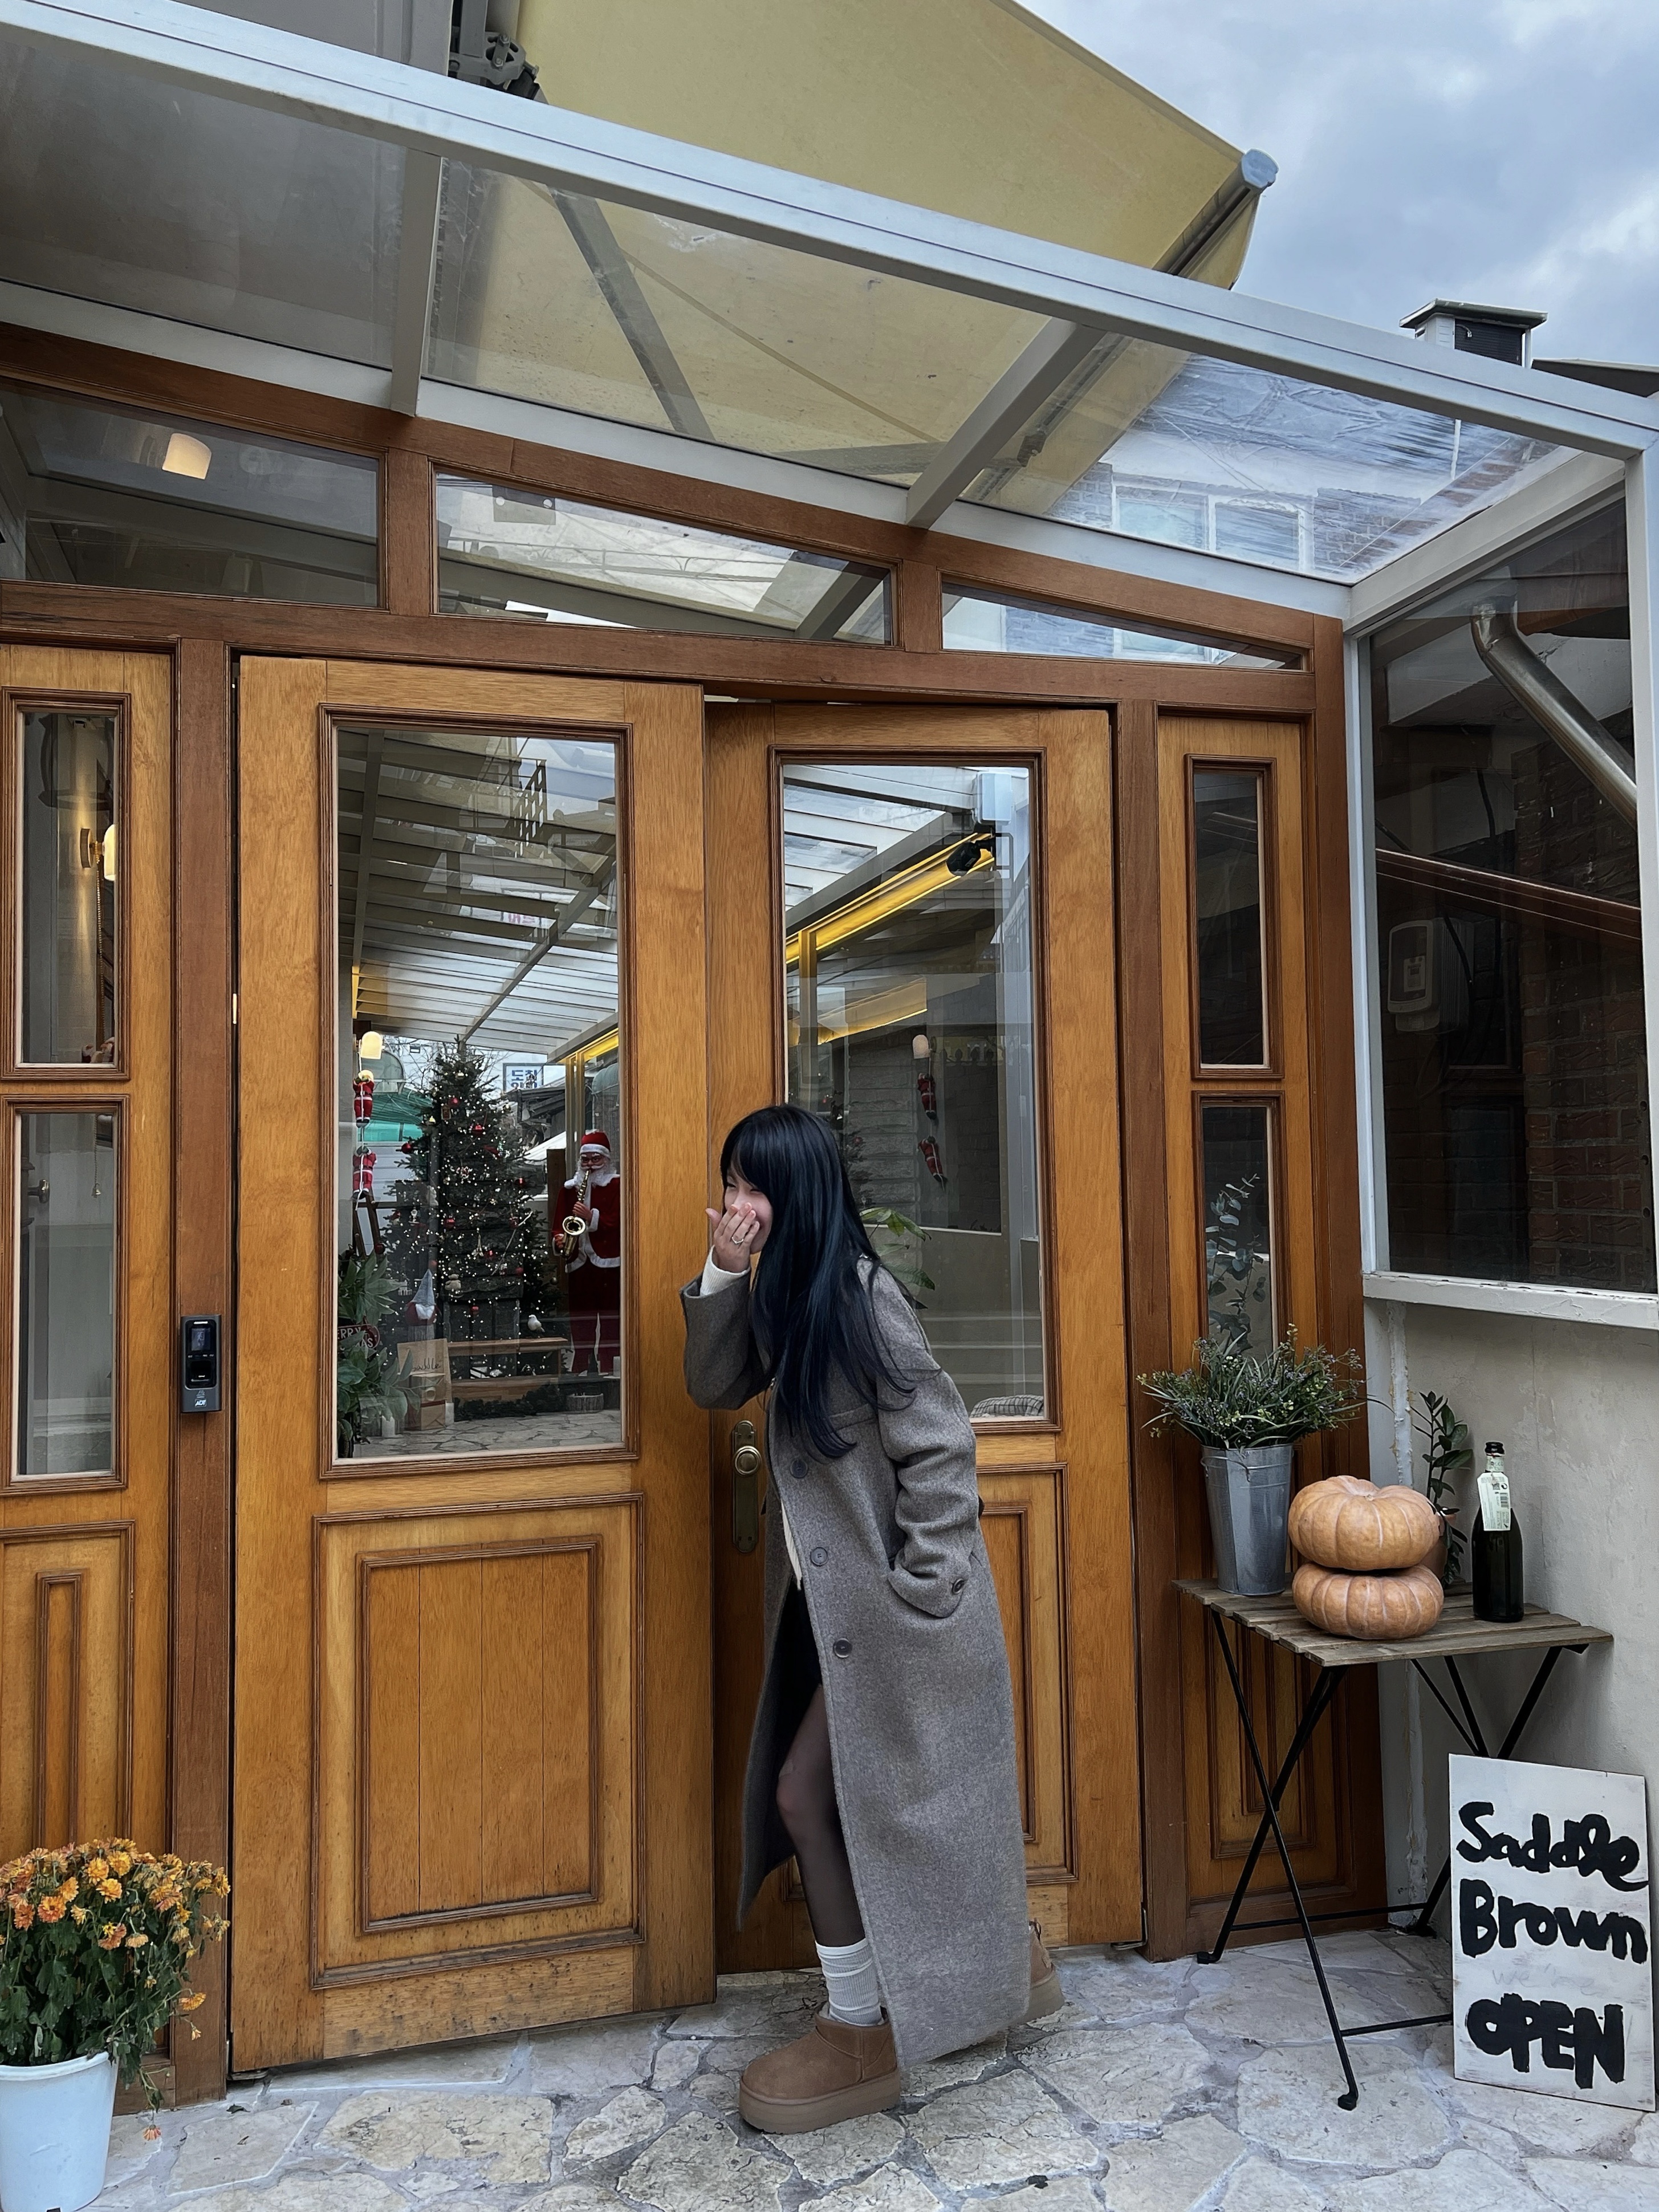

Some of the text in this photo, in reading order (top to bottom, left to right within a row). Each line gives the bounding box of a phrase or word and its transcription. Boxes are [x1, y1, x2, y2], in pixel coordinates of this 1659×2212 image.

[1456, 1801, 1649, 1892] Saddle
[1459, 1878, 1648, 1964] Brown
[1465, 1993, 1625, 2089] OPEN
